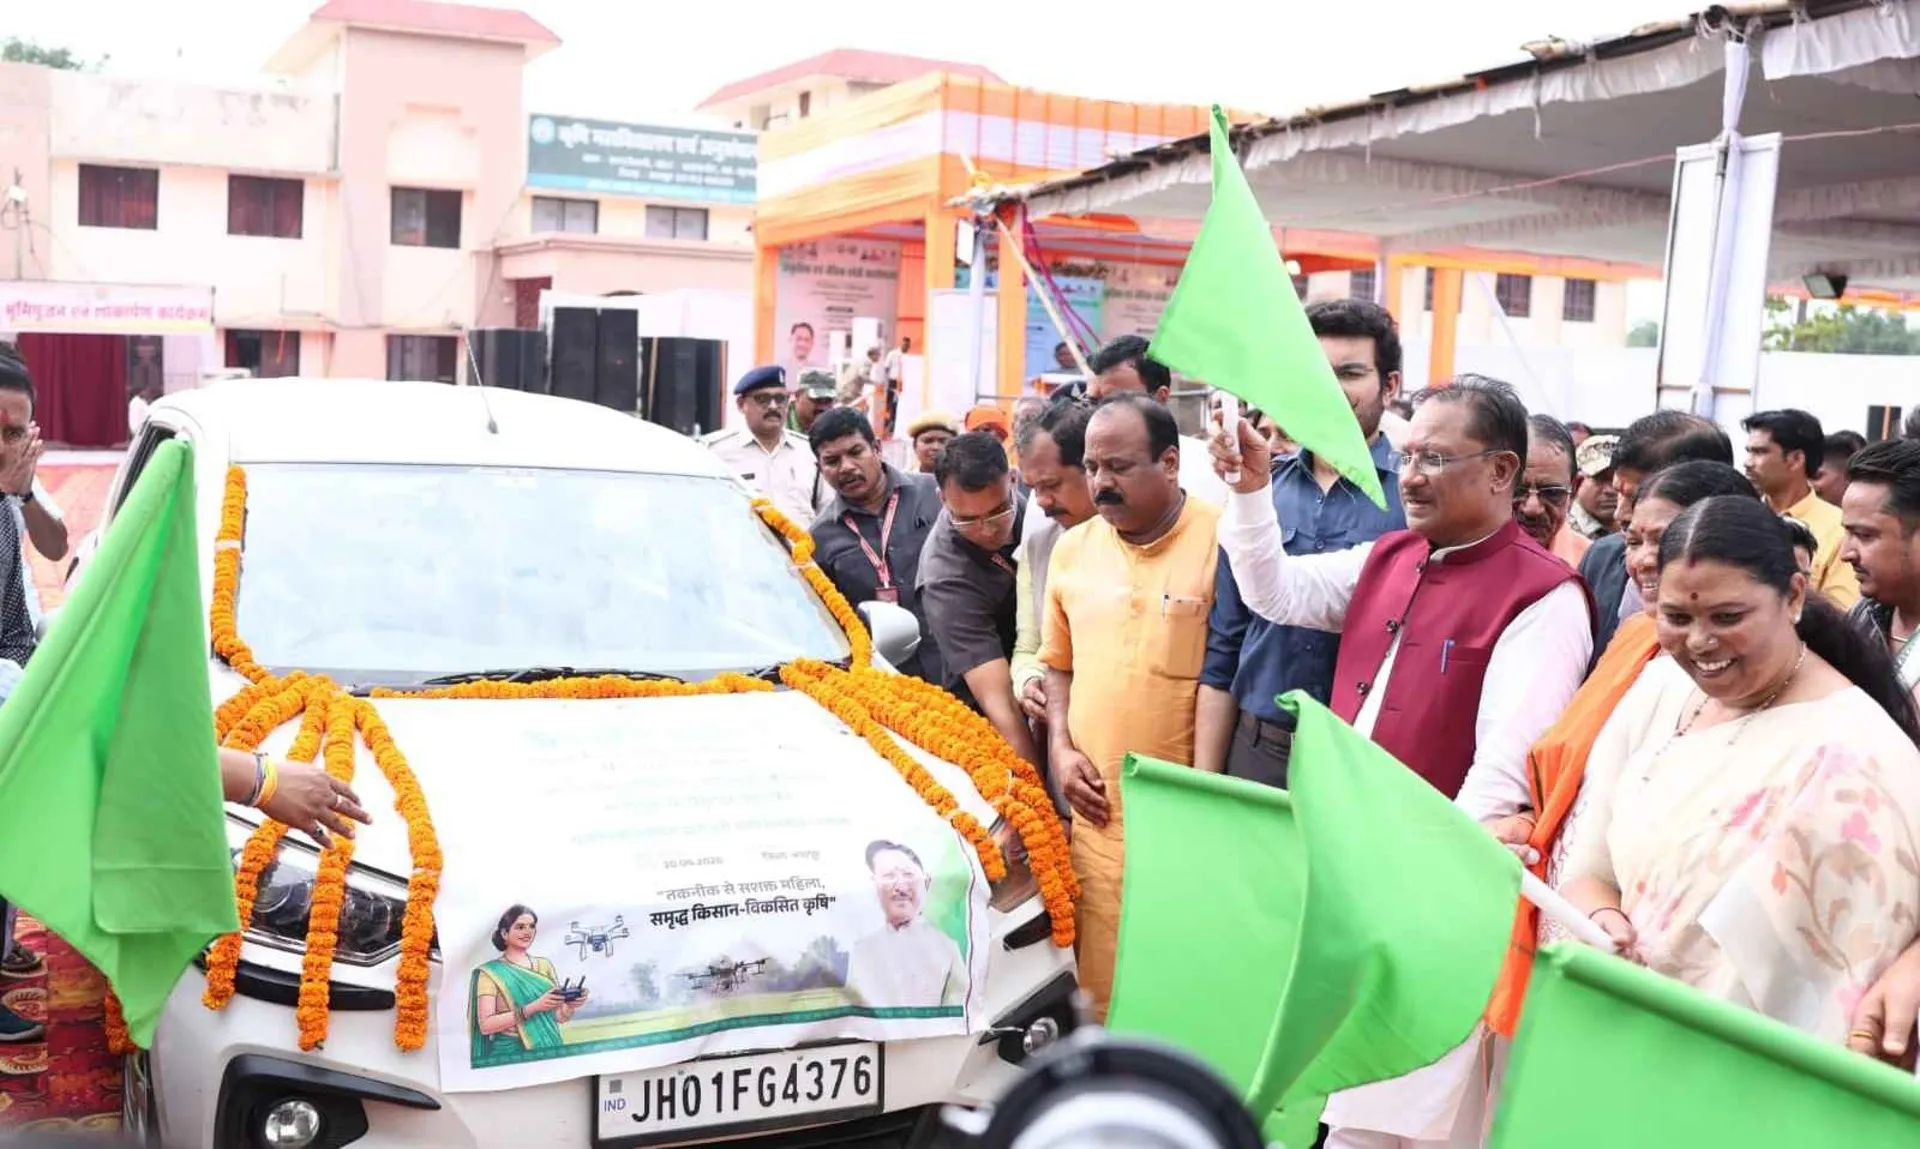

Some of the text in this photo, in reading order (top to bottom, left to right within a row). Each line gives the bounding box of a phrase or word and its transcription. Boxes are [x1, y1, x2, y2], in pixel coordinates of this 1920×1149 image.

[723, 880, 736, 895] से
[738, 880, 778, 895] सशक्त
[780, 875, 826, 892] महिला,
[649, 893, 837, 930] समृद्ध किसान-विकसित कृषि"
[631, 1055, 872, 1123] JH01FG4376
[603, 1098, 627, 1112] IND
